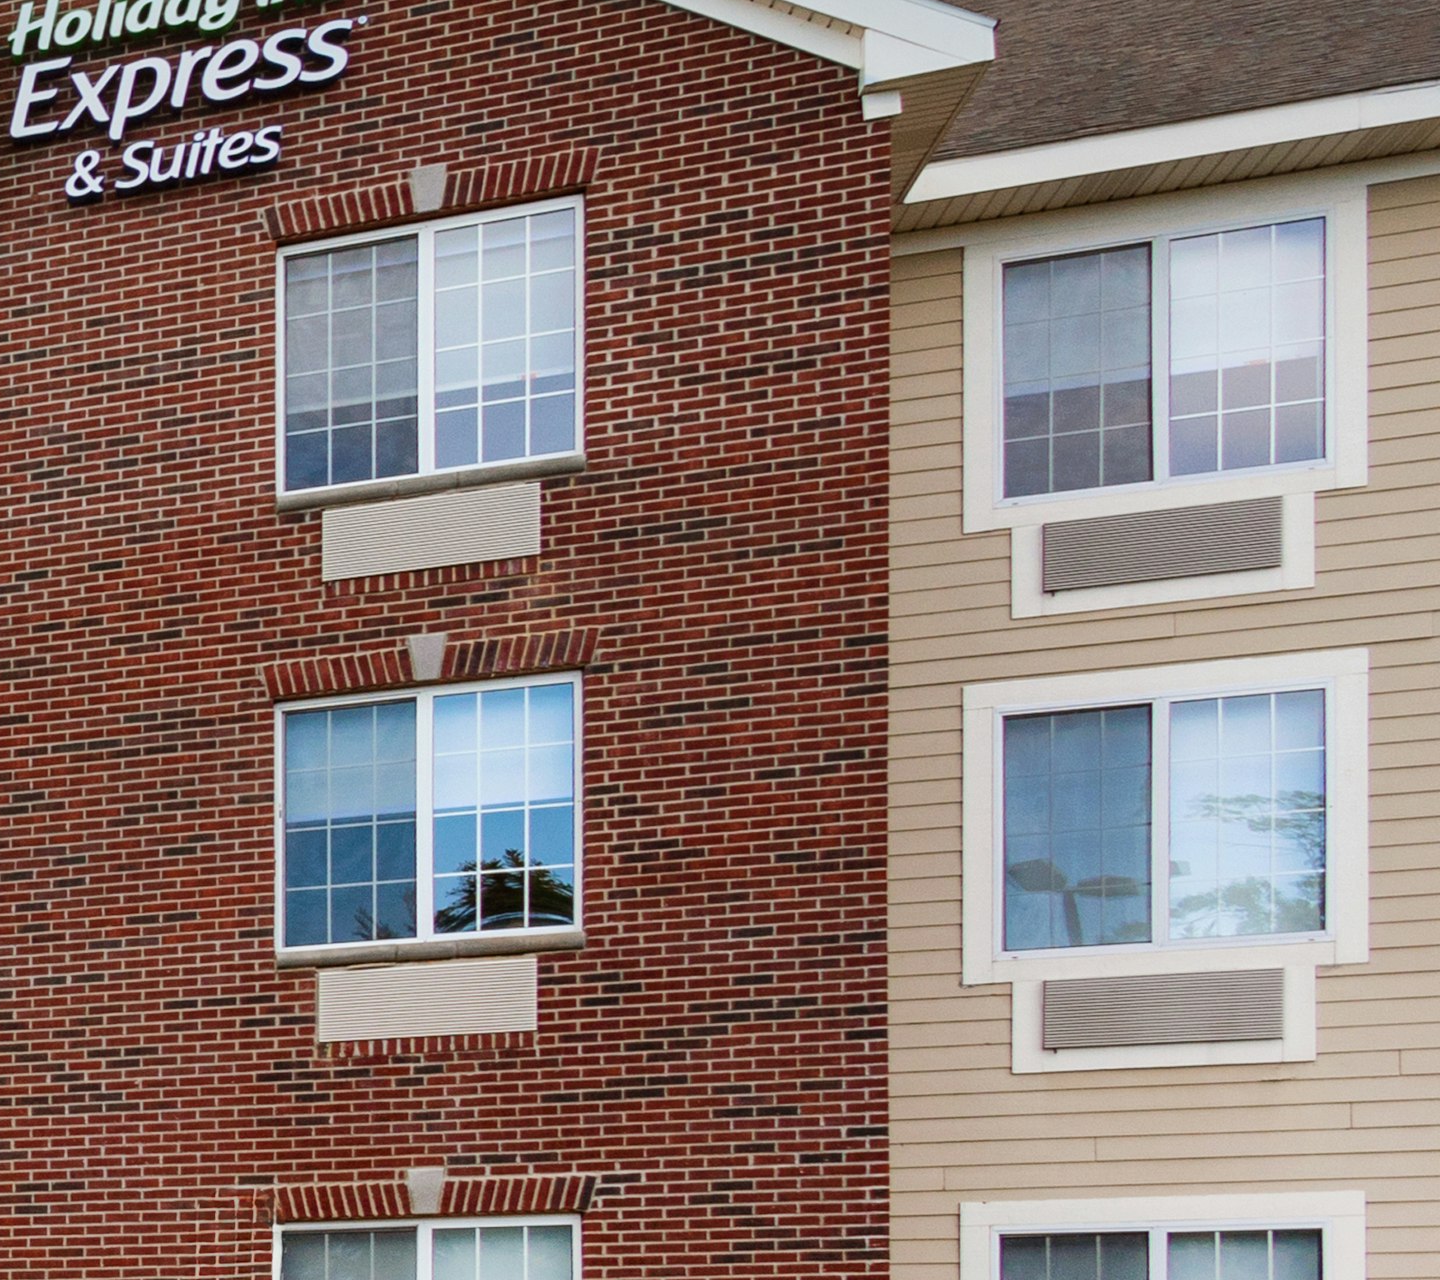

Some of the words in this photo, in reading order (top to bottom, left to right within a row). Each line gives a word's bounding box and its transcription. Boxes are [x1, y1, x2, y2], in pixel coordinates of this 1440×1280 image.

[10, 19, 355, 139] Express
[65, 150, 104, 198] &
[115, 125, 283, 189] Suites
